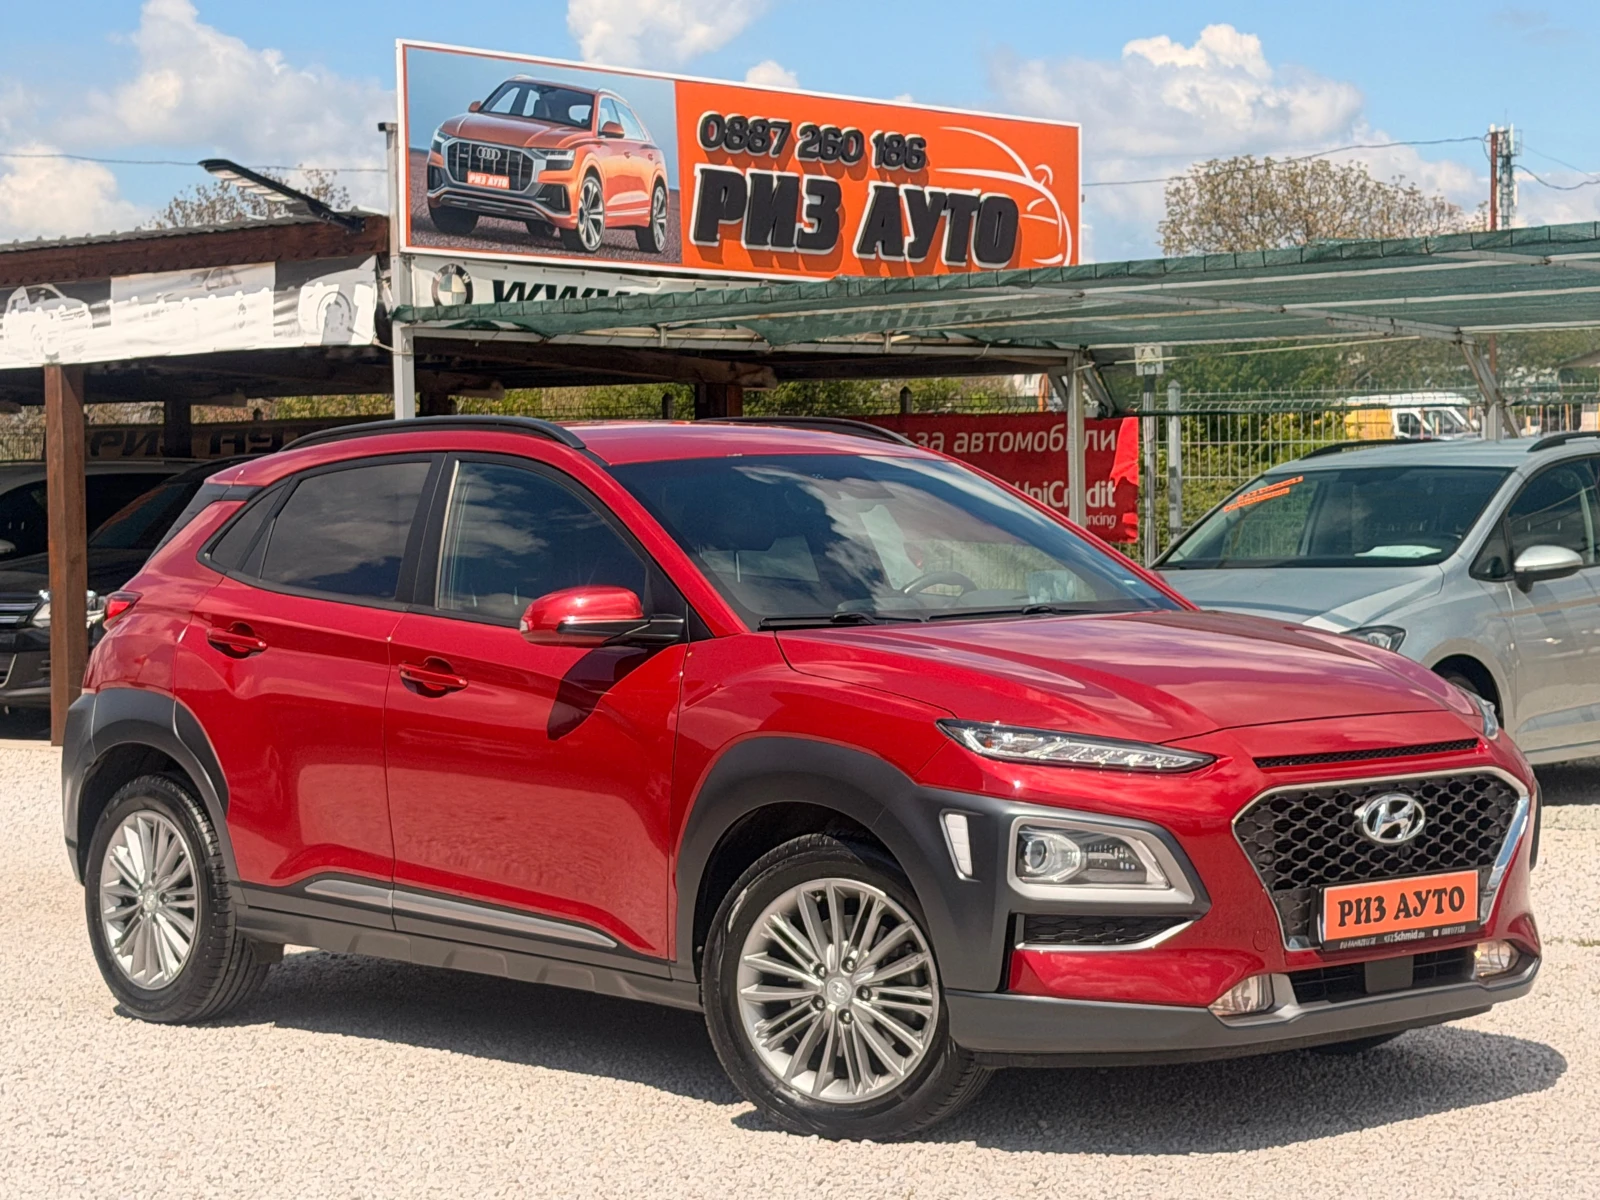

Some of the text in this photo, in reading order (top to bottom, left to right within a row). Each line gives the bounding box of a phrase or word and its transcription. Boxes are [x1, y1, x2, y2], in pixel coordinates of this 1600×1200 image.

[699, 111, 928, 171] 0887 260 186
[690, 163, 1020, 268] РИЗ АУТО
[953, 423, 1116, 453] автомобли
[1015, 481, 1116, 508] niCrdit
[1338, 886, 1465, 927] РИЗ АУТО
